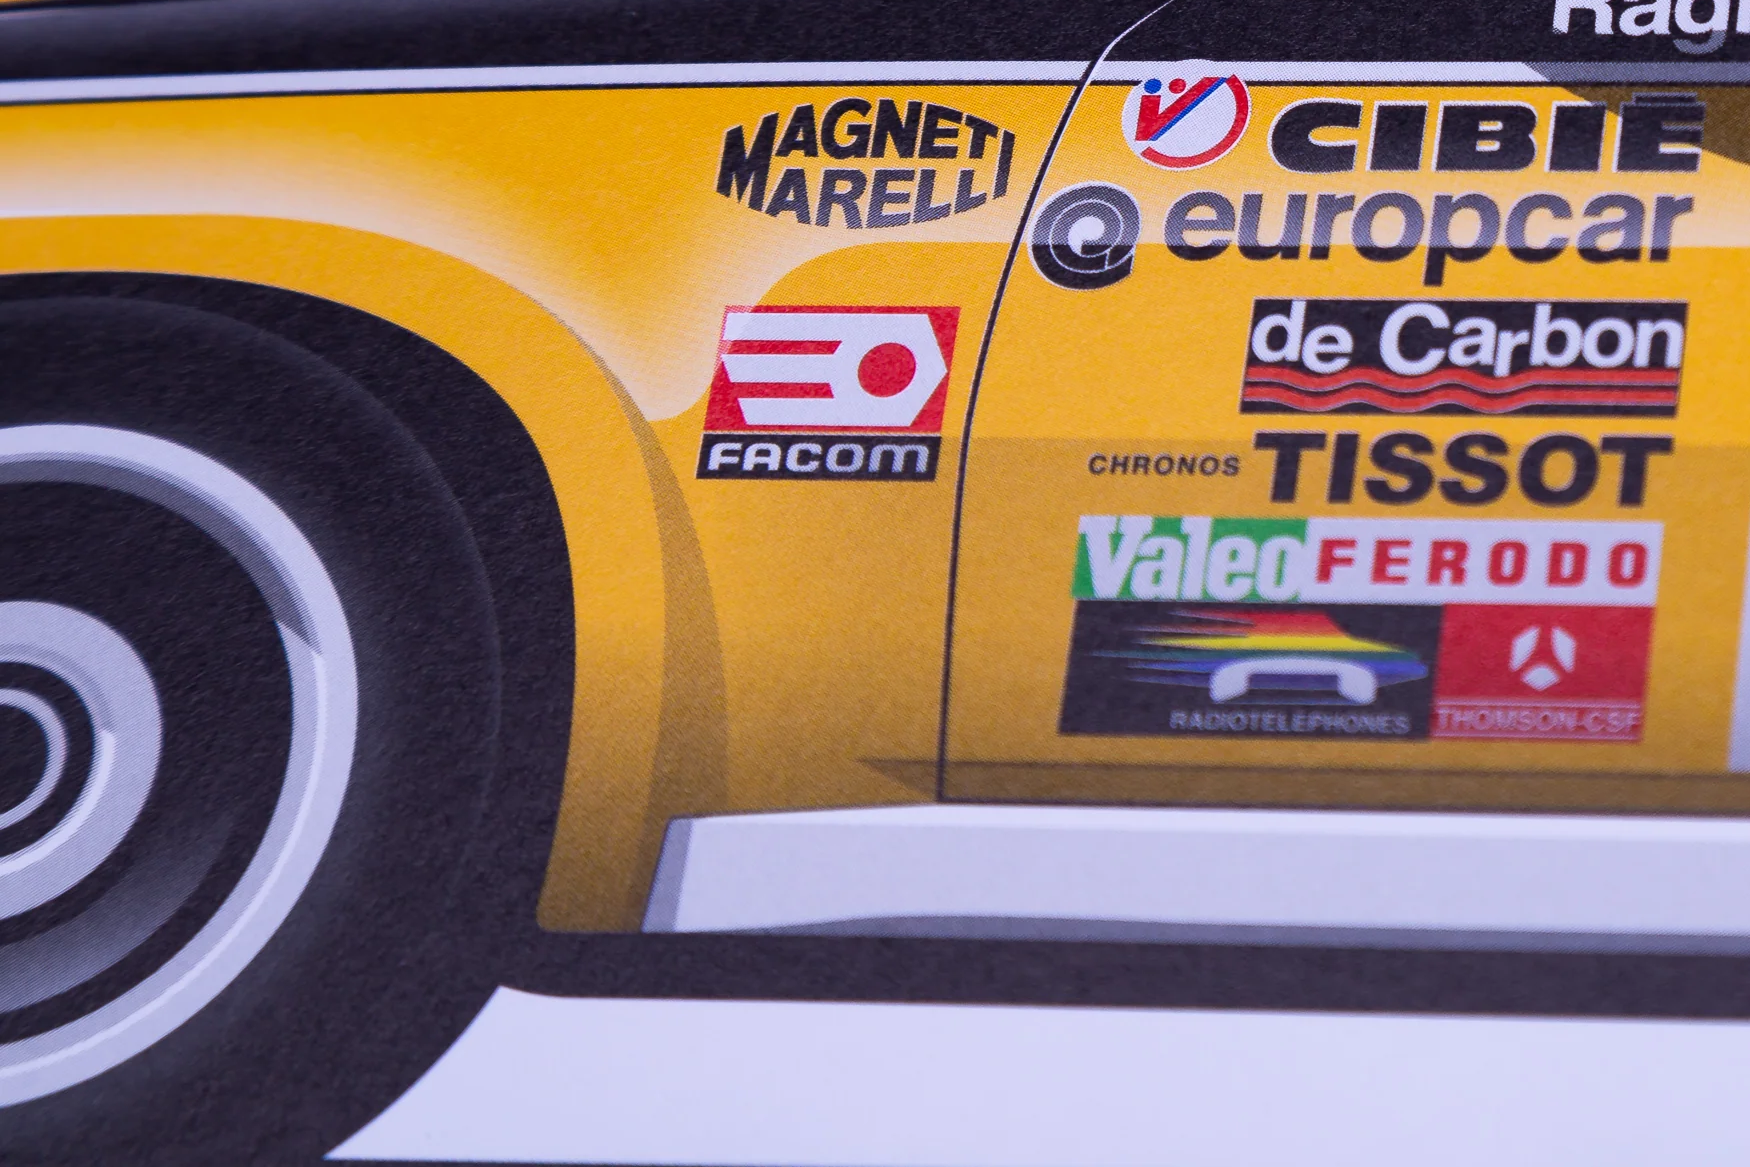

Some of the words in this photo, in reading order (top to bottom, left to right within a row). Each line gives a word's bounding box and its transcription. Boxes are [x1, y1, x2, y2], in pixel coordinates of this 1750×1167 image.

[716, 97, 1015, 211] MAGNETI
[1164, 190, 1694, 286] europcar
[1251, 300, 1354, 372] de
[1379, 302, 1684, 377] Carbon
[708, 443, 929, 473] FACOM
[1087, 454, 1241, 477] CHRONOS
[1253, 431, 1674, 506] TISSOT
[1082, 516, 1306, 600] Valeo
[1315, 538, 1648, 588] FERODO
[1435, 708, 1643, 731] THOMSON-CSF
